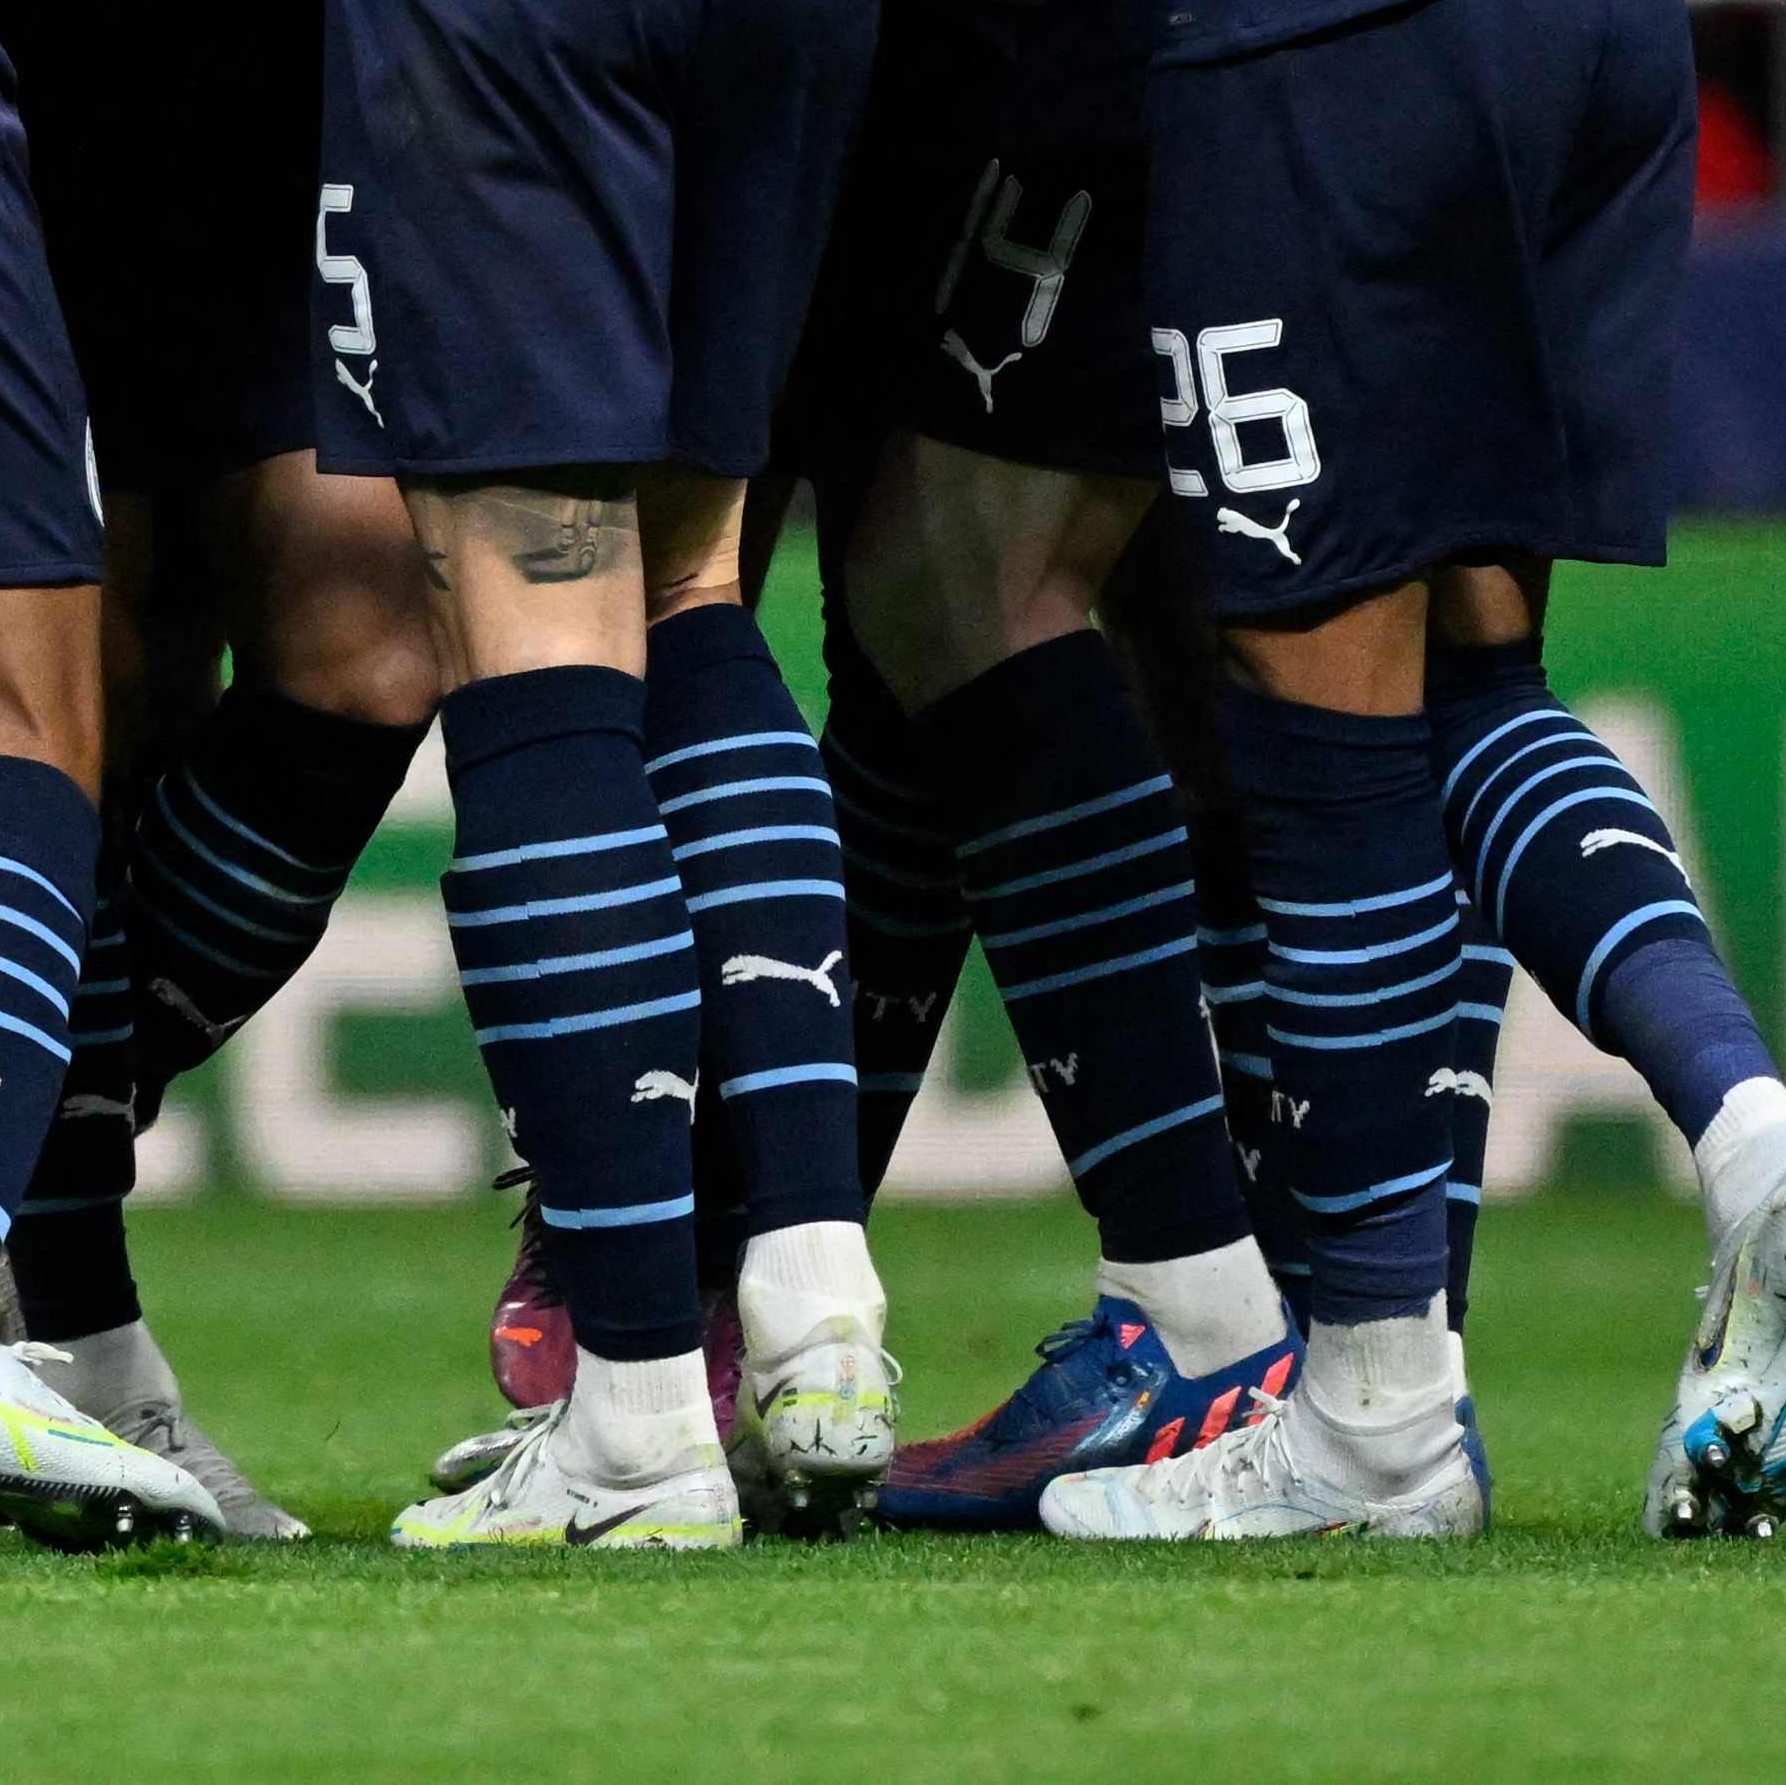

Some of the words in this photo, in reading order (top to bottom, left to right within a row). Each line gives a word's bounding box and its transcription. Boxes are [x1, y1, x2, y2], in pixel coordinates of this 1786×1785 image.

[315, 182, 377, 356] 5
[1151, 318, 1323, 499] 26
[1030, 1051, 1079, 1095] TY
